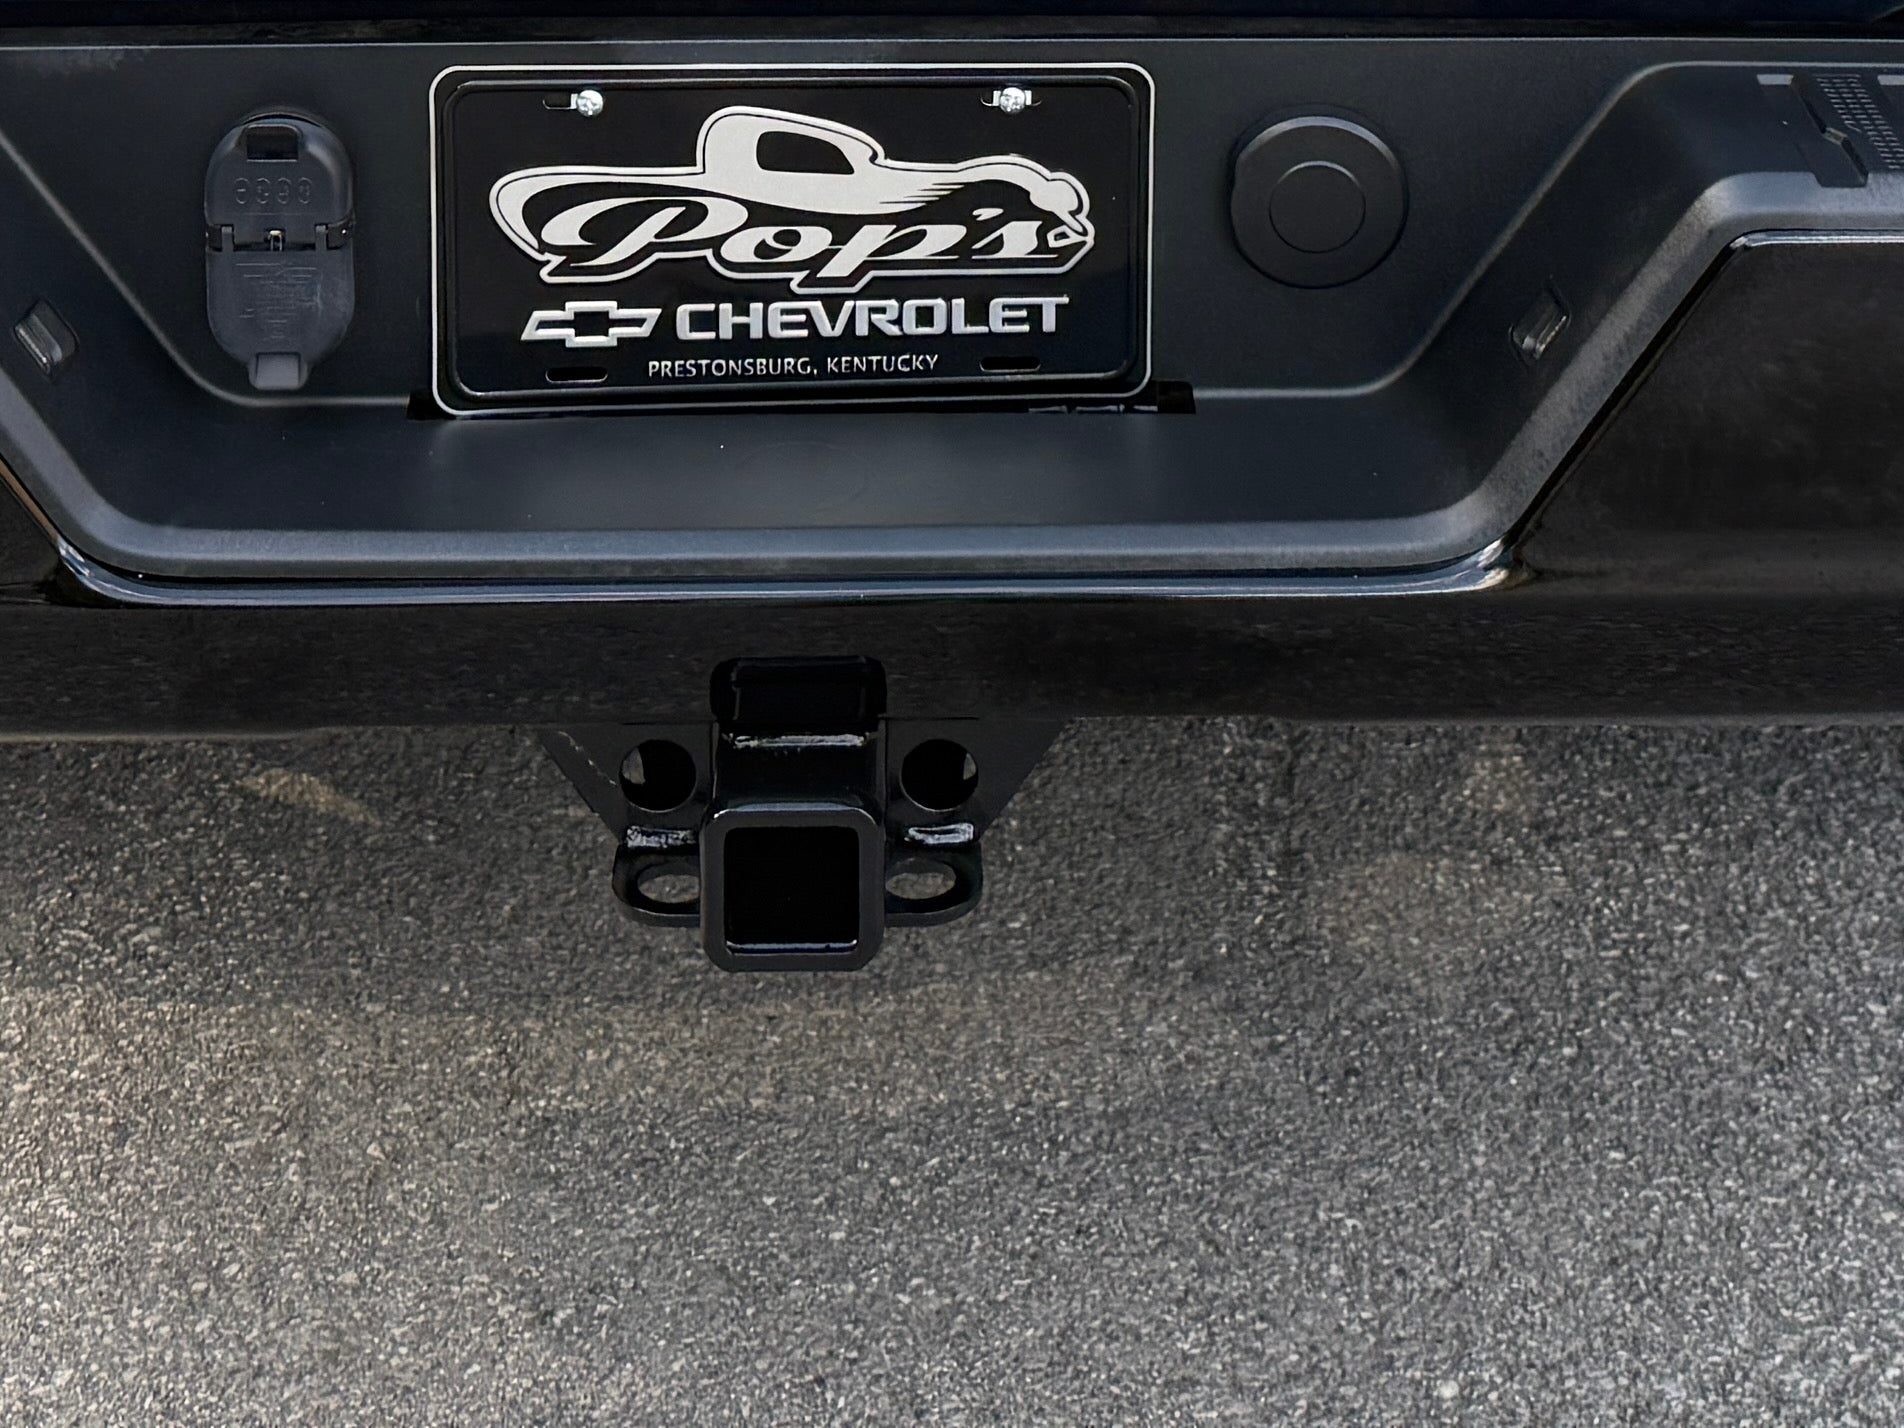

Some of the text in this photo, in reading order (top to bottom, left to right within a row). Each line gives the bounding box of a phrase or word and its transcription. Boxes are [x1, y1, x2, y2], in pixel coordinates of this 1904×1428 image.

[539, 196, 1065, 278] Pop's
[675, 294, 1070, 341] CHEVROLET
[648, 354, 939, 377] PRESTONSBURG, KENTUCKY
